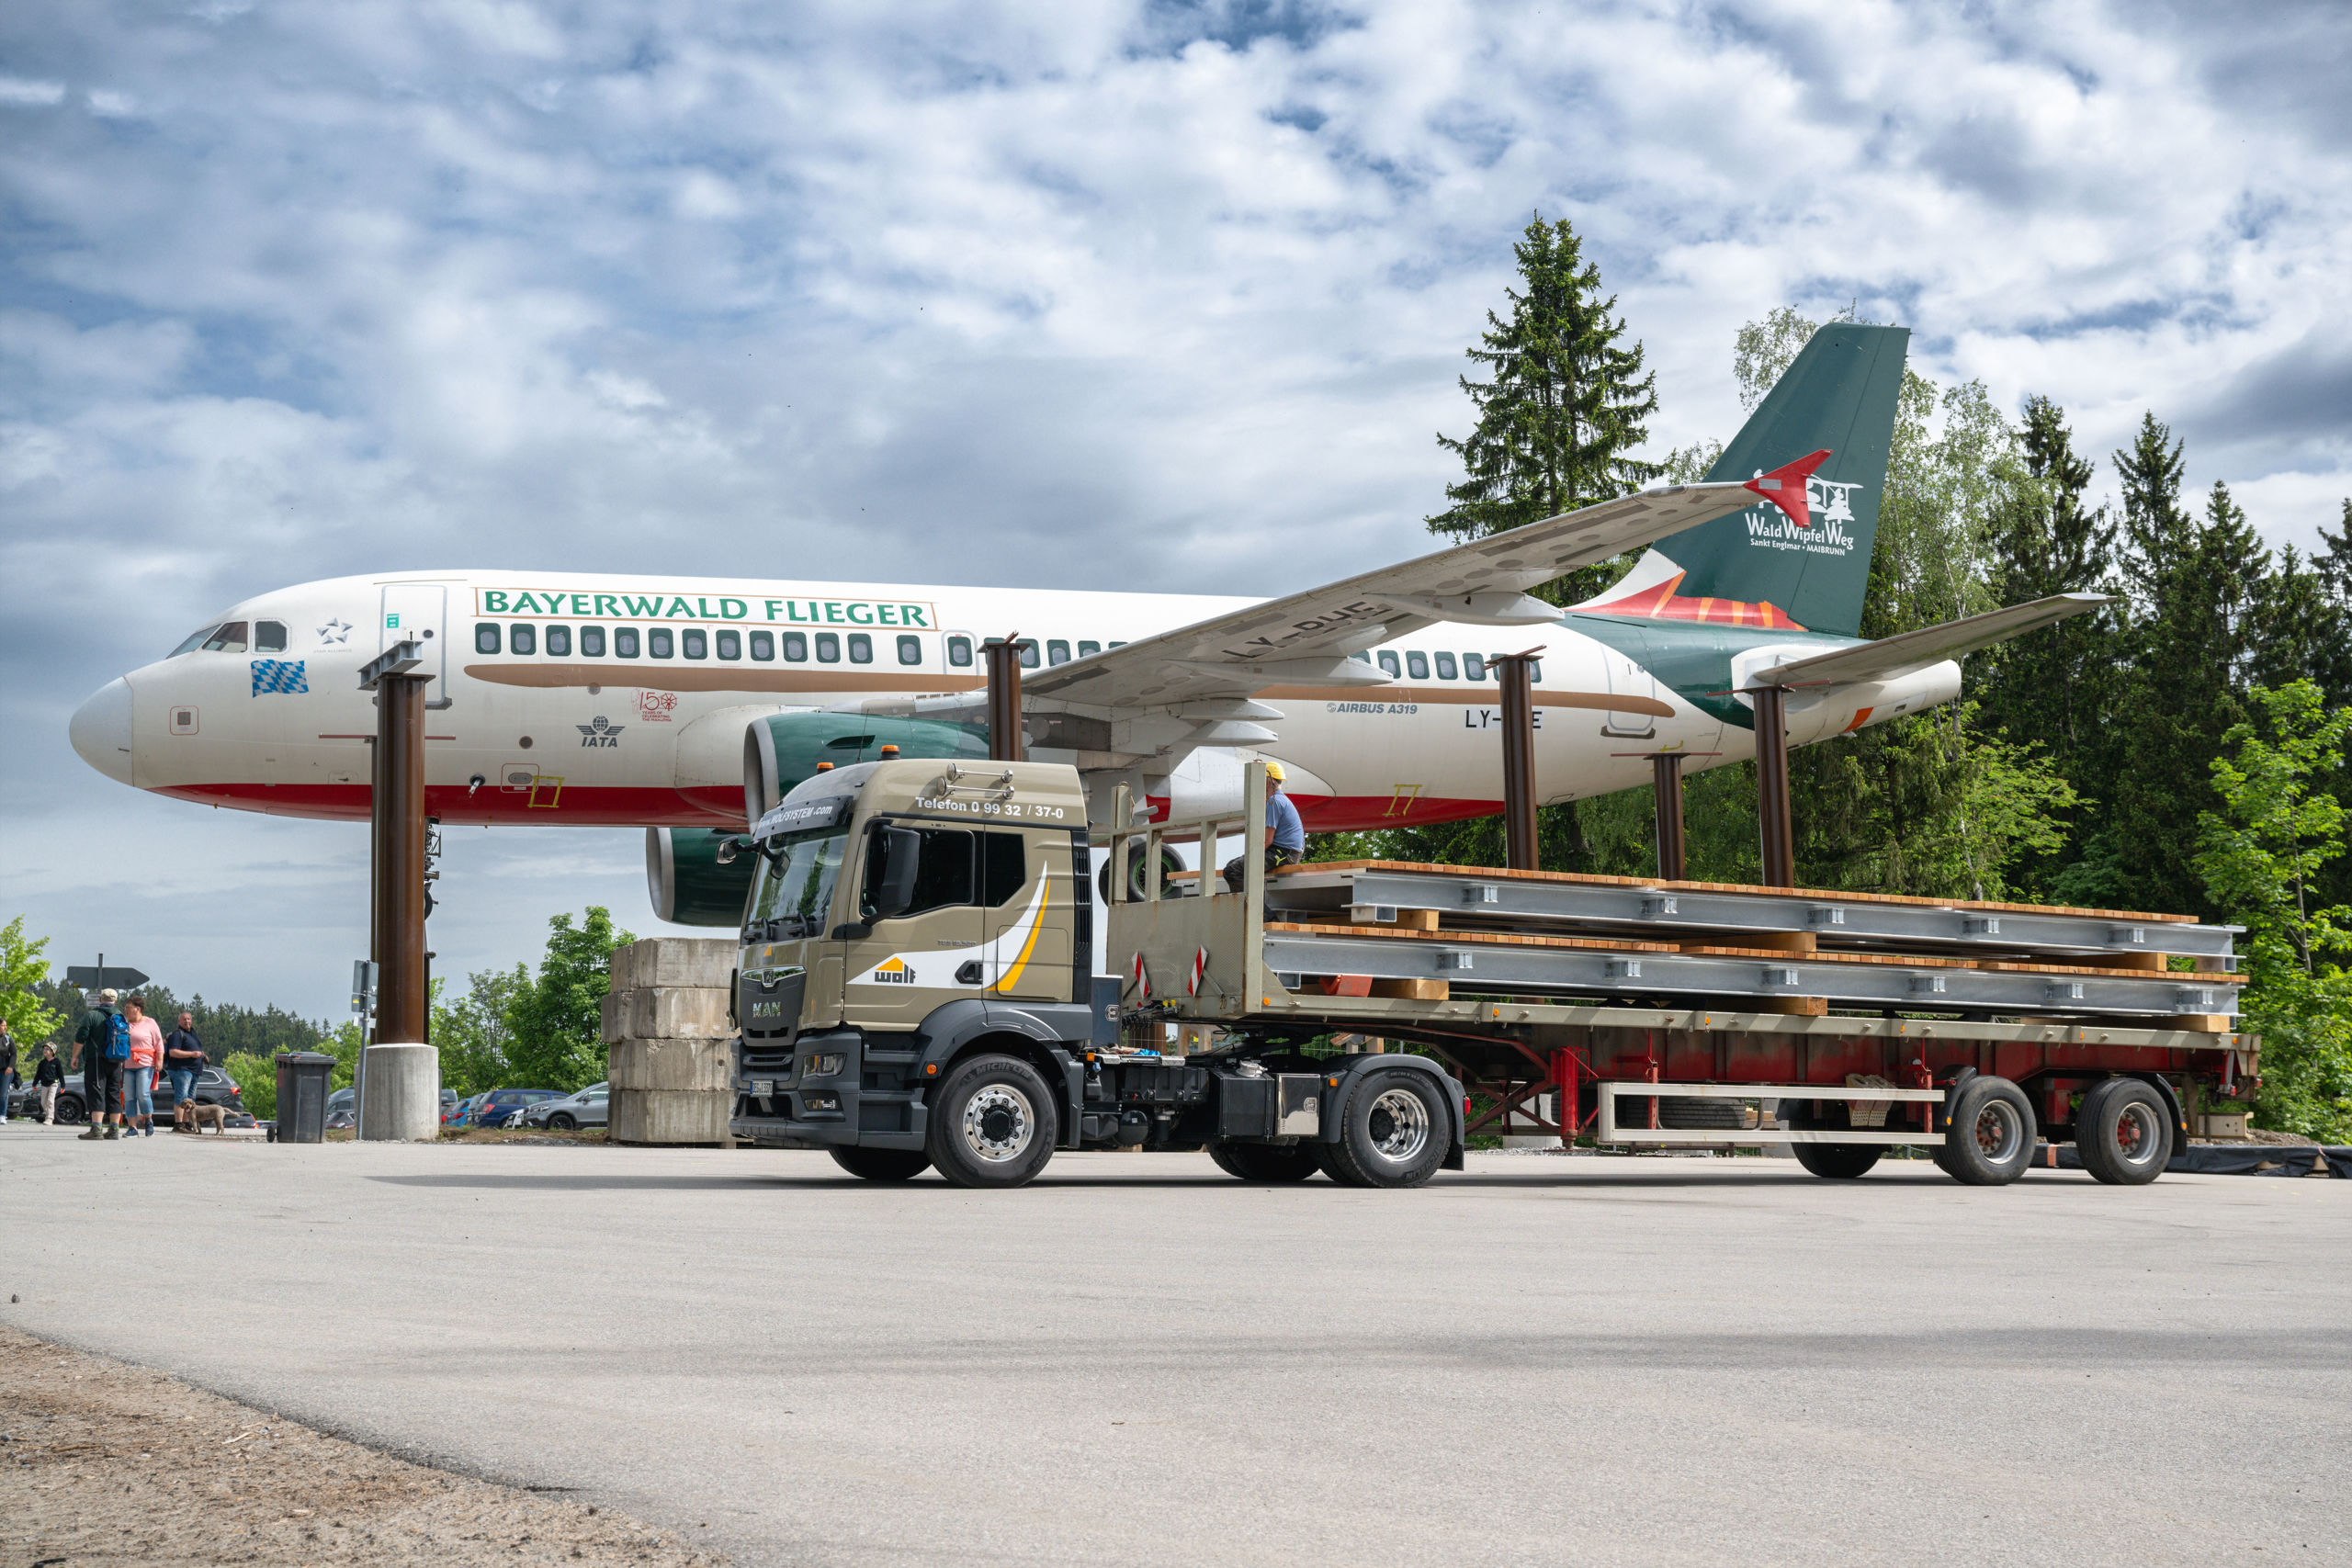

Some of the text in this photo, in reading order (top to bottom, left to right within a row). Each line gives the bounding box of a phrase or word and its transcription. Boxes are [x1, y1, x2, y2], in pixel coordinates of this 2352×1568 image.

[1750, 538, 1846, 556] Sankt Englmar MAIBRUNN
[484, 591, 929, 626] BAYERWALD FLIEGER
[1337, 703, 1418, 714] AIRBUS A319
[582, 737, 617, 748] IATA
[915, 796, 967, 812] Telefon
[971, 801, 980, 813] 0
[984, 803, 1001, 814] 99
[1004, 805, 1021, 817] 32
[1035, 806, 1064, 818] 37-0
[875, 964, 916, 984] wolf
[752, 1001, 781, 1018] MAN
[976, 1062, 1031, 1078] MICHELIN
